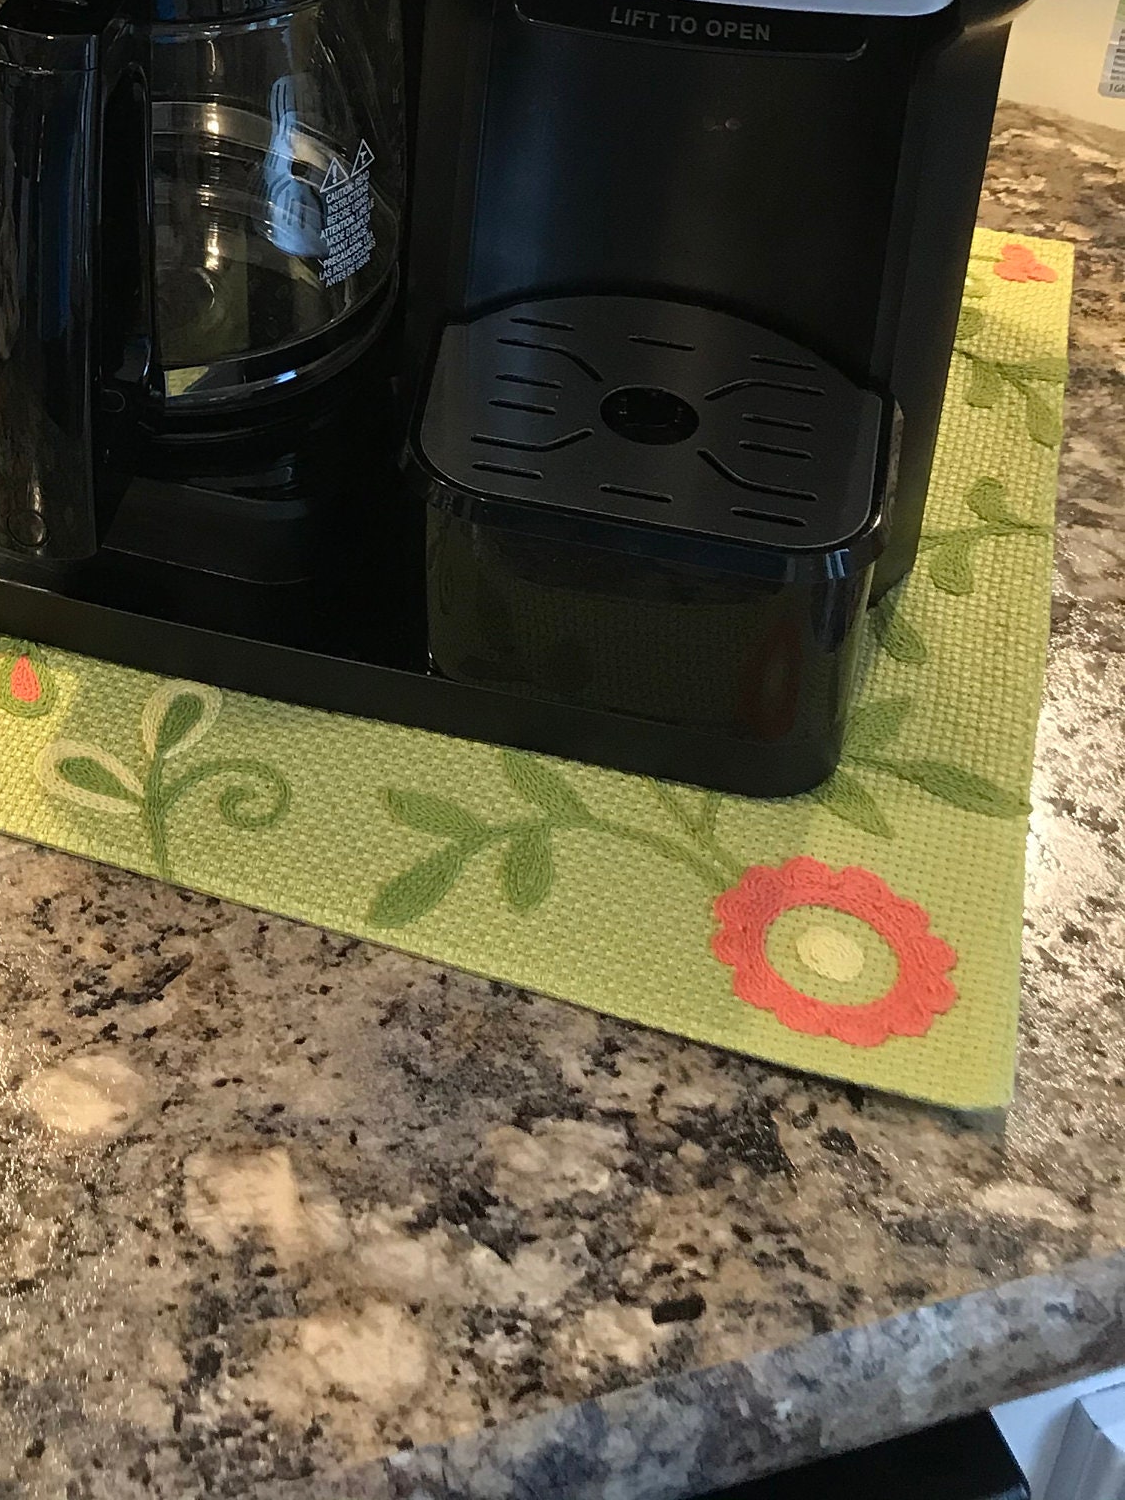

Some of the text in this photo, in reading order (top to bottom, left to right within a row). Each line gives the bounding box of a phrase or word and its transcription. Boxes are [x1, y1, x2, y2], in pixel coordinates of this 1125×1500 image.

[610, 6, 771, 41] LIFT TO OPEN
[328, 183, 369, 214] INSTRUCTIONS
[327, 206, 351, 226] BEFORE
[329, 239, 348, 255] AVANT
[319, 267, 331, 281] LAS
[326, 272, 346, 288] ANTES
